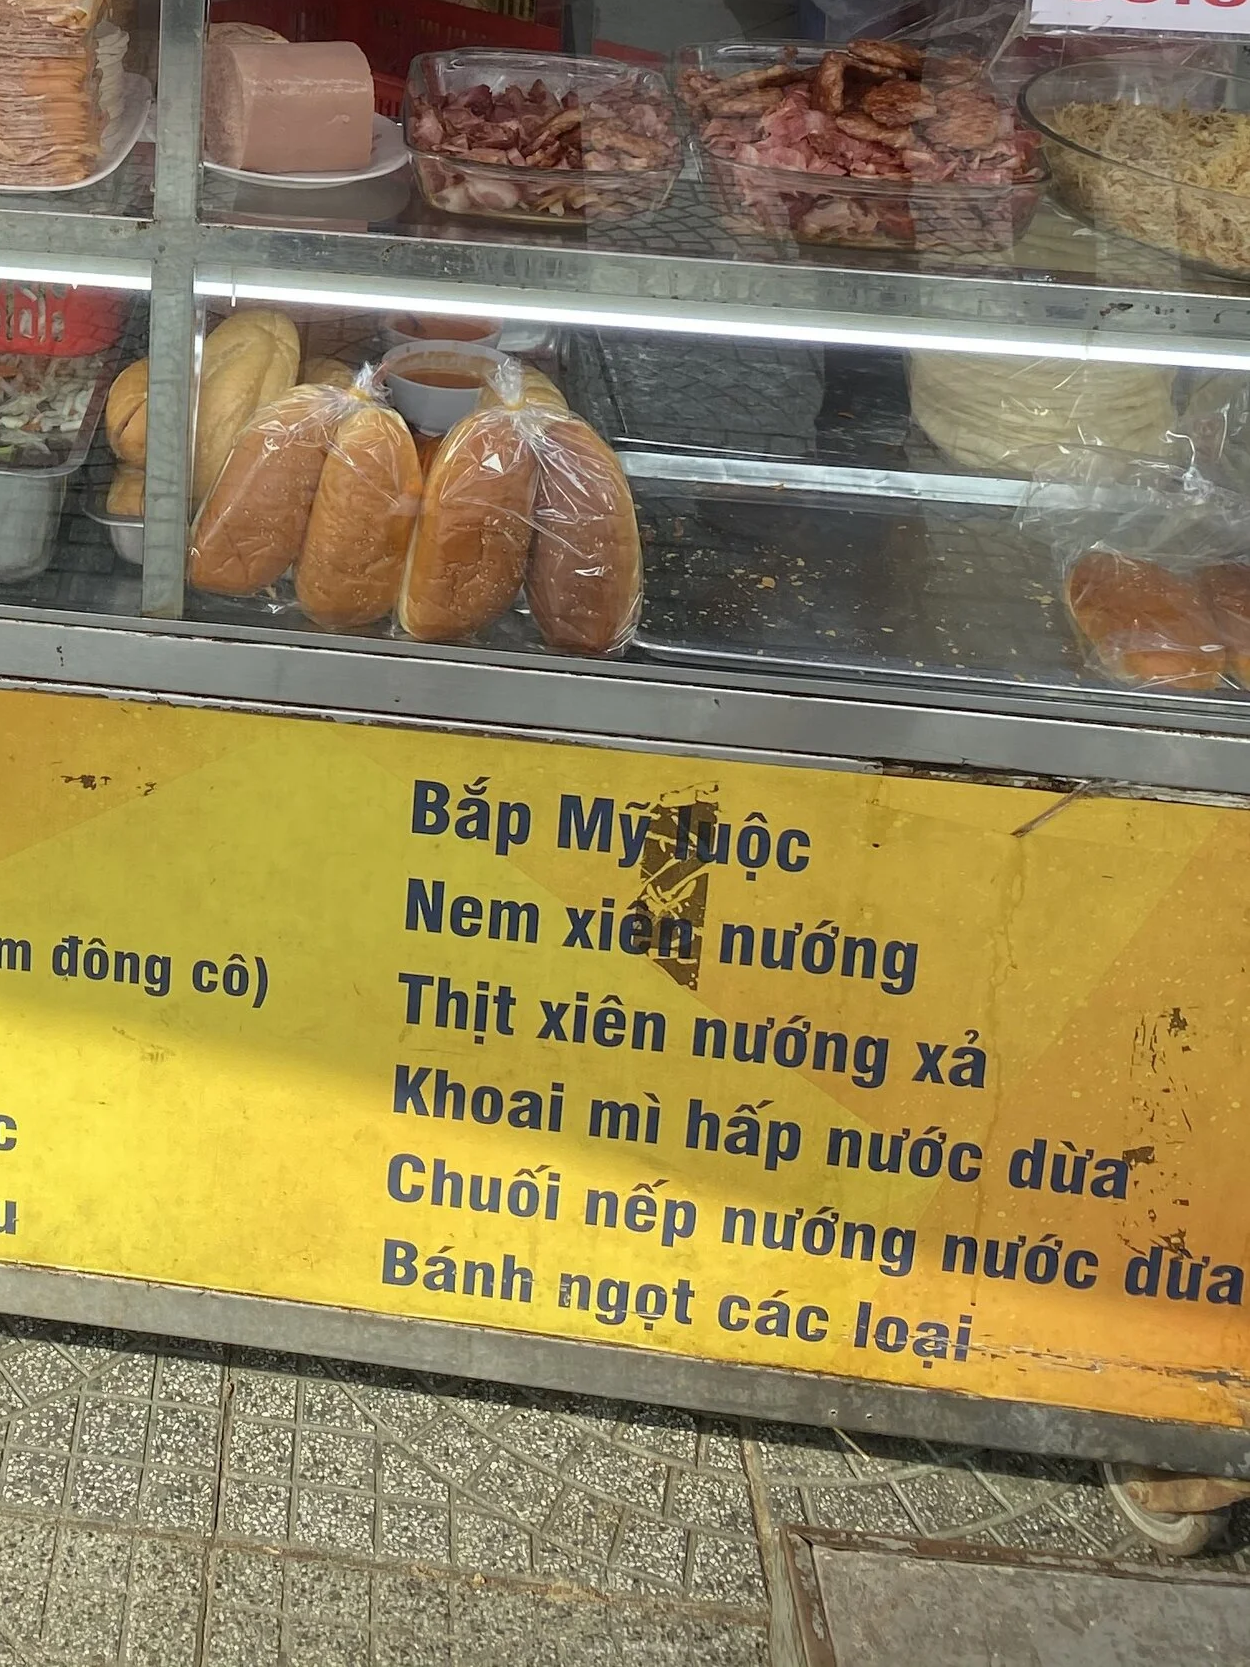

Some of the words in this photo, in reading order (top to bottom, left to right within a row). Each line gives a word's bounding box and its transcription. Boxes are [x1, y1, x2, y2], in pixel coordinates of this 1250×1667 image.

[410, 776, 533, 855] Bắp
[557, 794, 655, 868] Mỹ
[673, 799, 813, 883] luộc
[51, 935, 171, 998] đông
[190, 954, 271, 1009] cô)
[405, 878, 540, 944] Nem
[562, 897, 693, 960] xiên
[720, 918, 920, 996] nướng
[398, 972, 516, 1045] Thịt
[537, 991, 666, 1052] xiên
[692, 1014, 891, 1089] nướng
[913, 1029, 989, 1088] xả
[392, 1065, 564, 1132] Khoai
[589, 1091, 661, 1146] mì
[686, 1098, 800, 1170] hấp
[827, 1122, 983, 1183] nước
[1008, 1138, 1131, 1201] dừa
[387, 1152, 561, 1221] Chuối
[585, 1178, 697, 1249] nếp
[721, 1202, 917, 1277] nướng
[942, 1230, 1098, 1290] nước
[1124, 1246, 1246, 1305] dừa
[381, 1239, 533, 1302] Bánh
[558, 1268, 695, 1332] ngọt
[717, 1290, 830, 1344] các
[855, 1300, 974, 1368] loại
